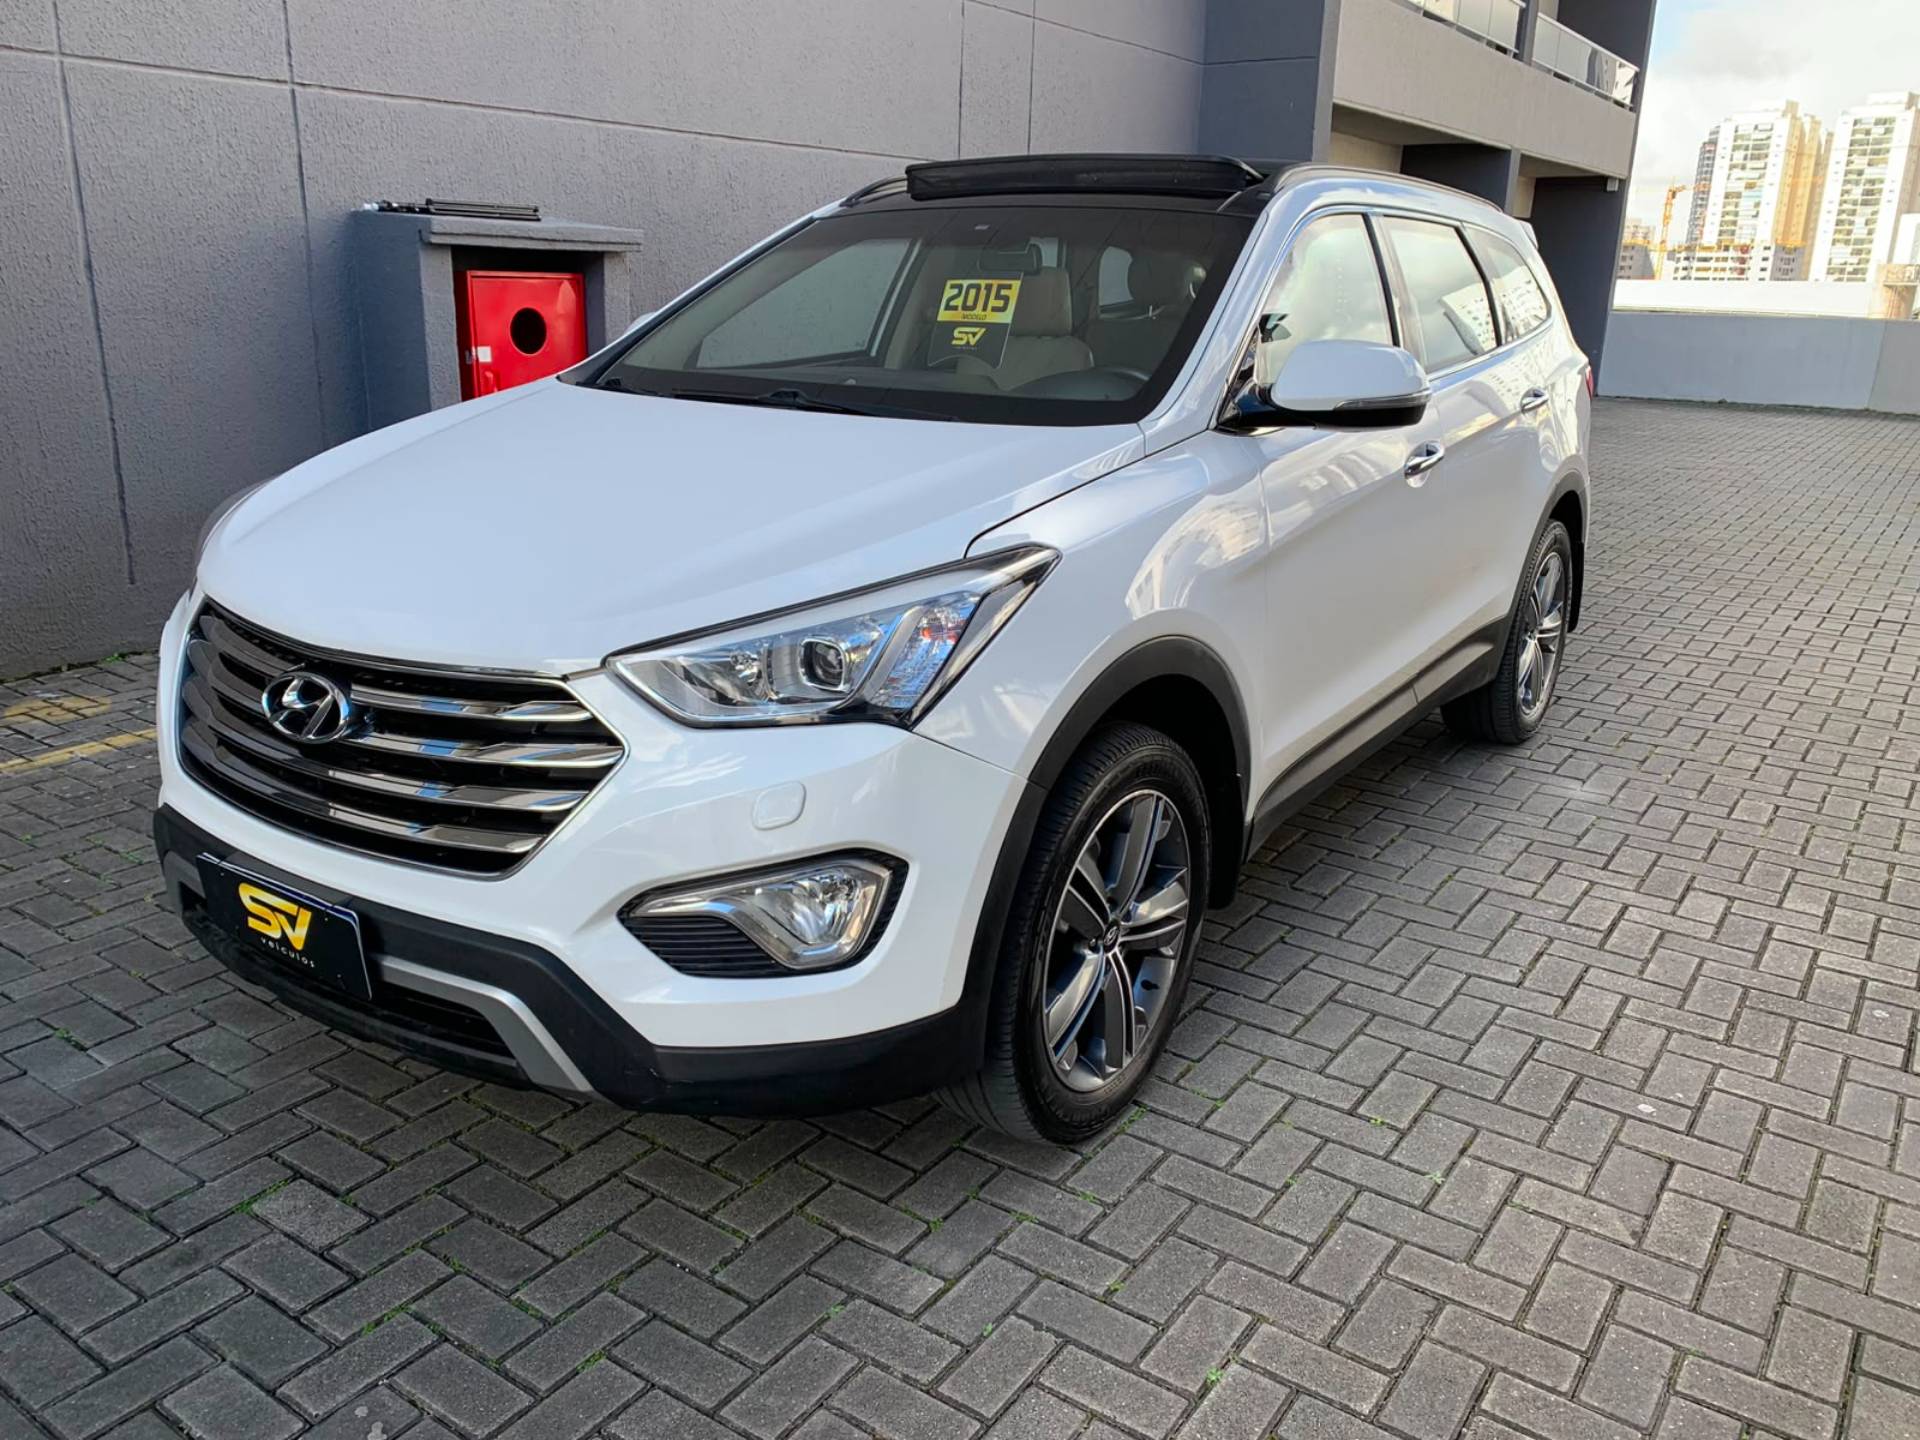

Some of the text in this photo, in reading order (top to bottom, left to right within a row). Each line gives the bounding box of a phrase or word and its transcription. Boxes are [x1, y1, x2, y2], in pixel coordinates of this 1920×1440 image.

[944, 283, 1012, 312] 2015
[952, 326, 986, 346] SV
[238, 882, 312, 951] SV
